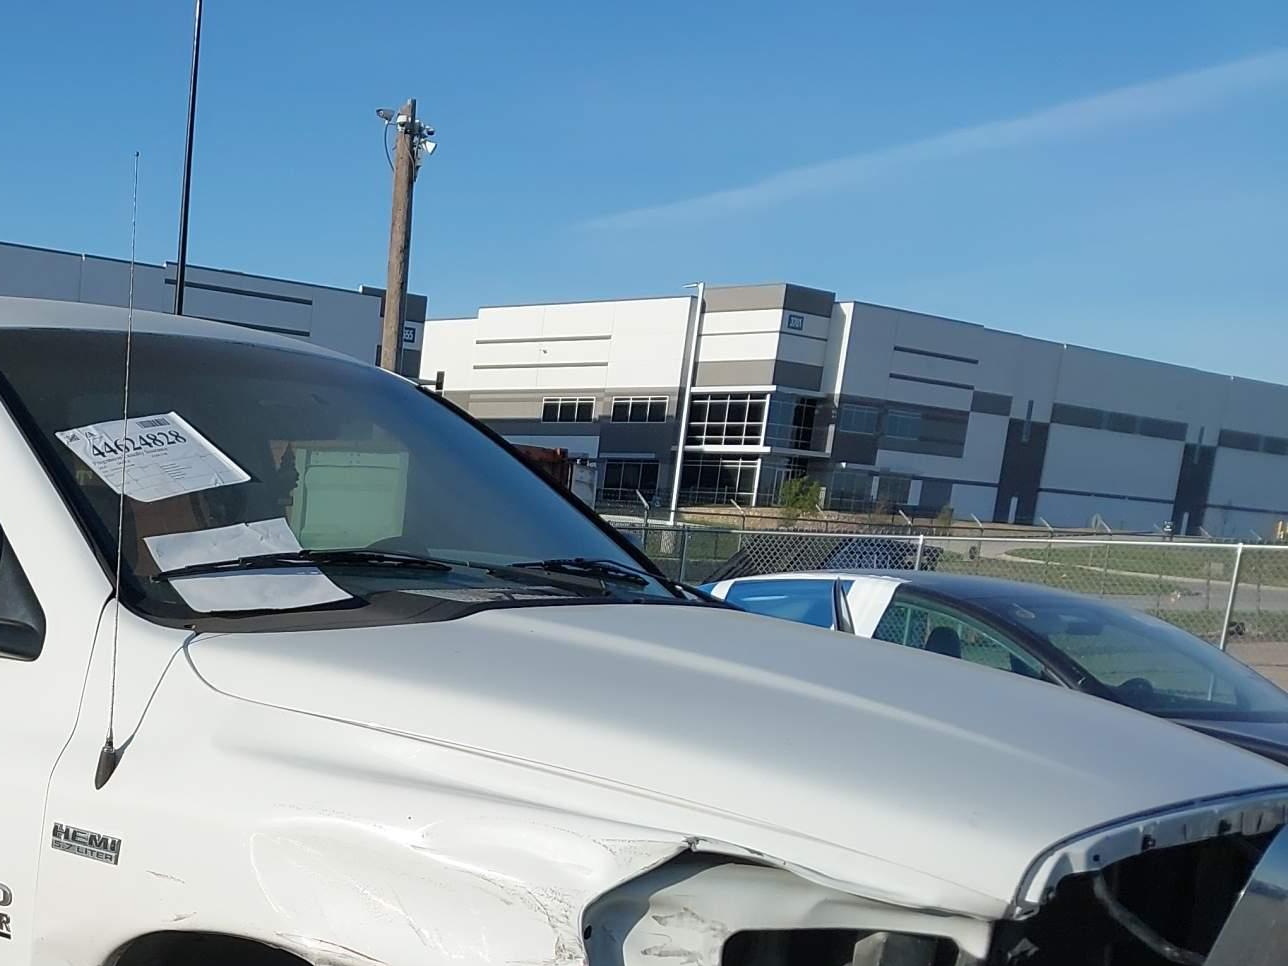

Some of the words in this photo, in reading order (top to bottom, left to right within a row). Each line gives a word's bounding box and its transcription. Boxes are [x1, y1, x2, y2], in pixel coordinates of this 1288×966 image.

[91, 430, 187, 458] 44624828
[53, 823, 120, 852] HEMI
[76, 845, 113, 862] LITER
